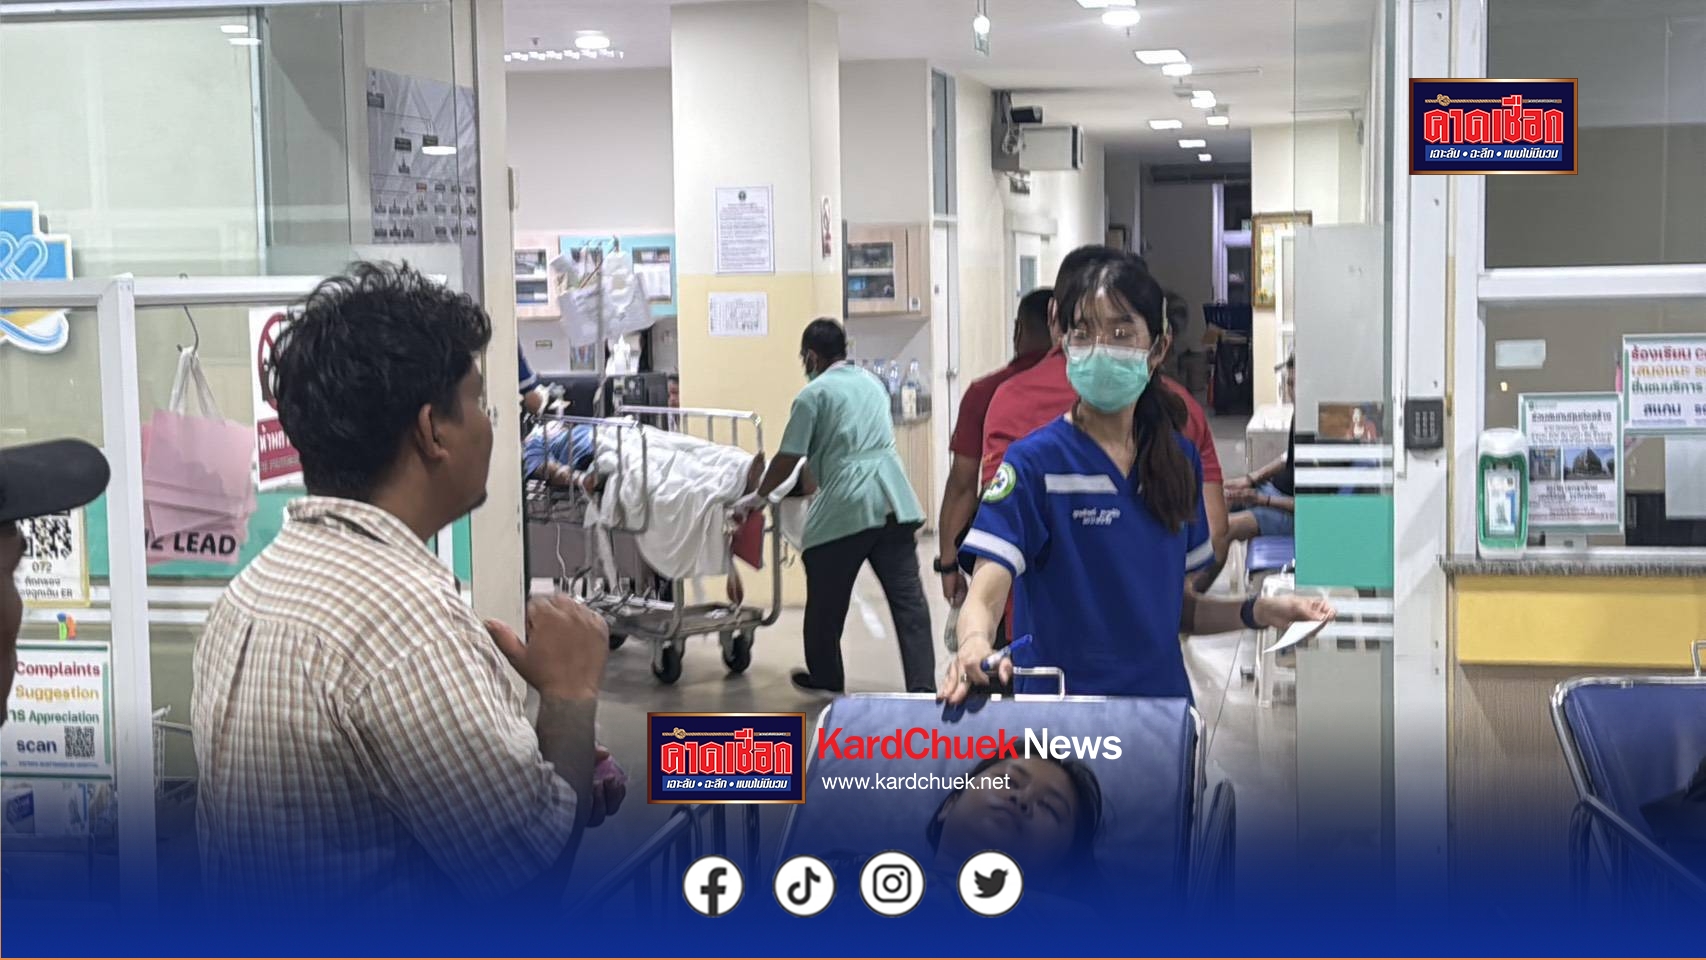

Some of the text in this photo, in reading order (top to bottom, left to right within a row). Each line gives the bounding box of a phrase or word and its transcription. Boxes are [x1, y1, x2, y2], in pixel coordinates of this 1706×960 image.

[173, 532, 237, 556] LEAD
[16, 661, 101, 679] Complaints
[15, 684, 100, 703] Suggestion
[29, 709, 100, 726] Appreciation
[16, 739, 58, 754] scan
